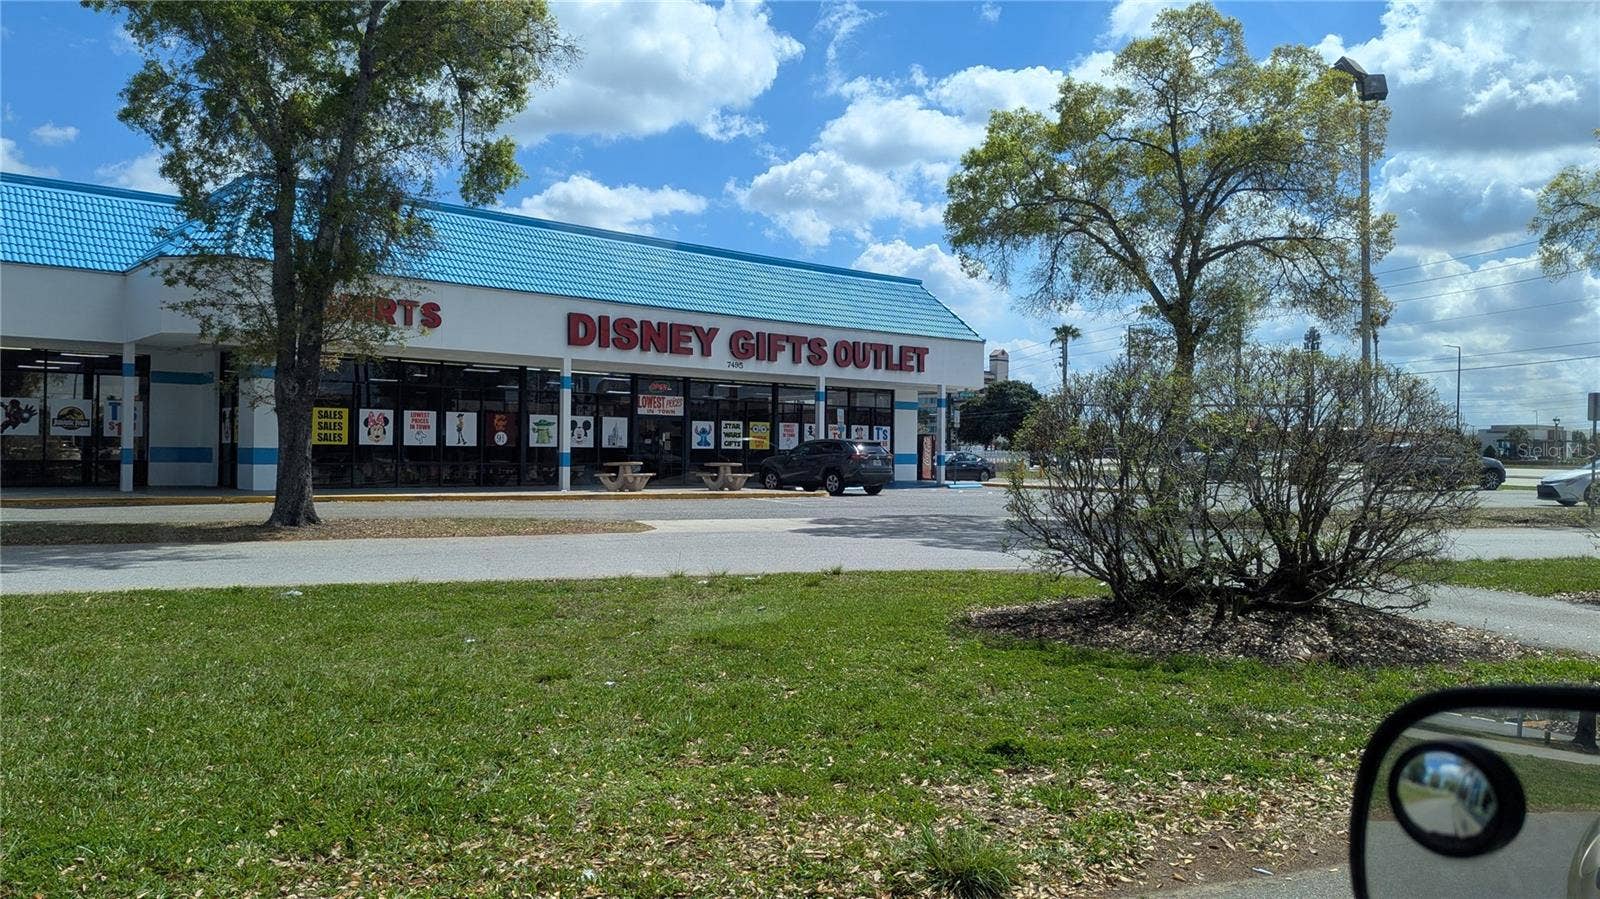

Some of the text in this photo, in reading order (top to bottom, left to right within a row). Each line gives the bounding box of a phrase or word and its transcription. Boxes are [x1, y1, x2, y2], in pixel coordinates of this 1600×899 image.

[567, 312, 929, 373] DISNEY GIFTS OUTLET
[727, 361, 744, 370] 7495
[637, 395, 666, 409] LOWEST
[317, 410, 343, 420] SALES
[317, 421, 343, 431] SALES
[317, 432, 343, 442] SALES
